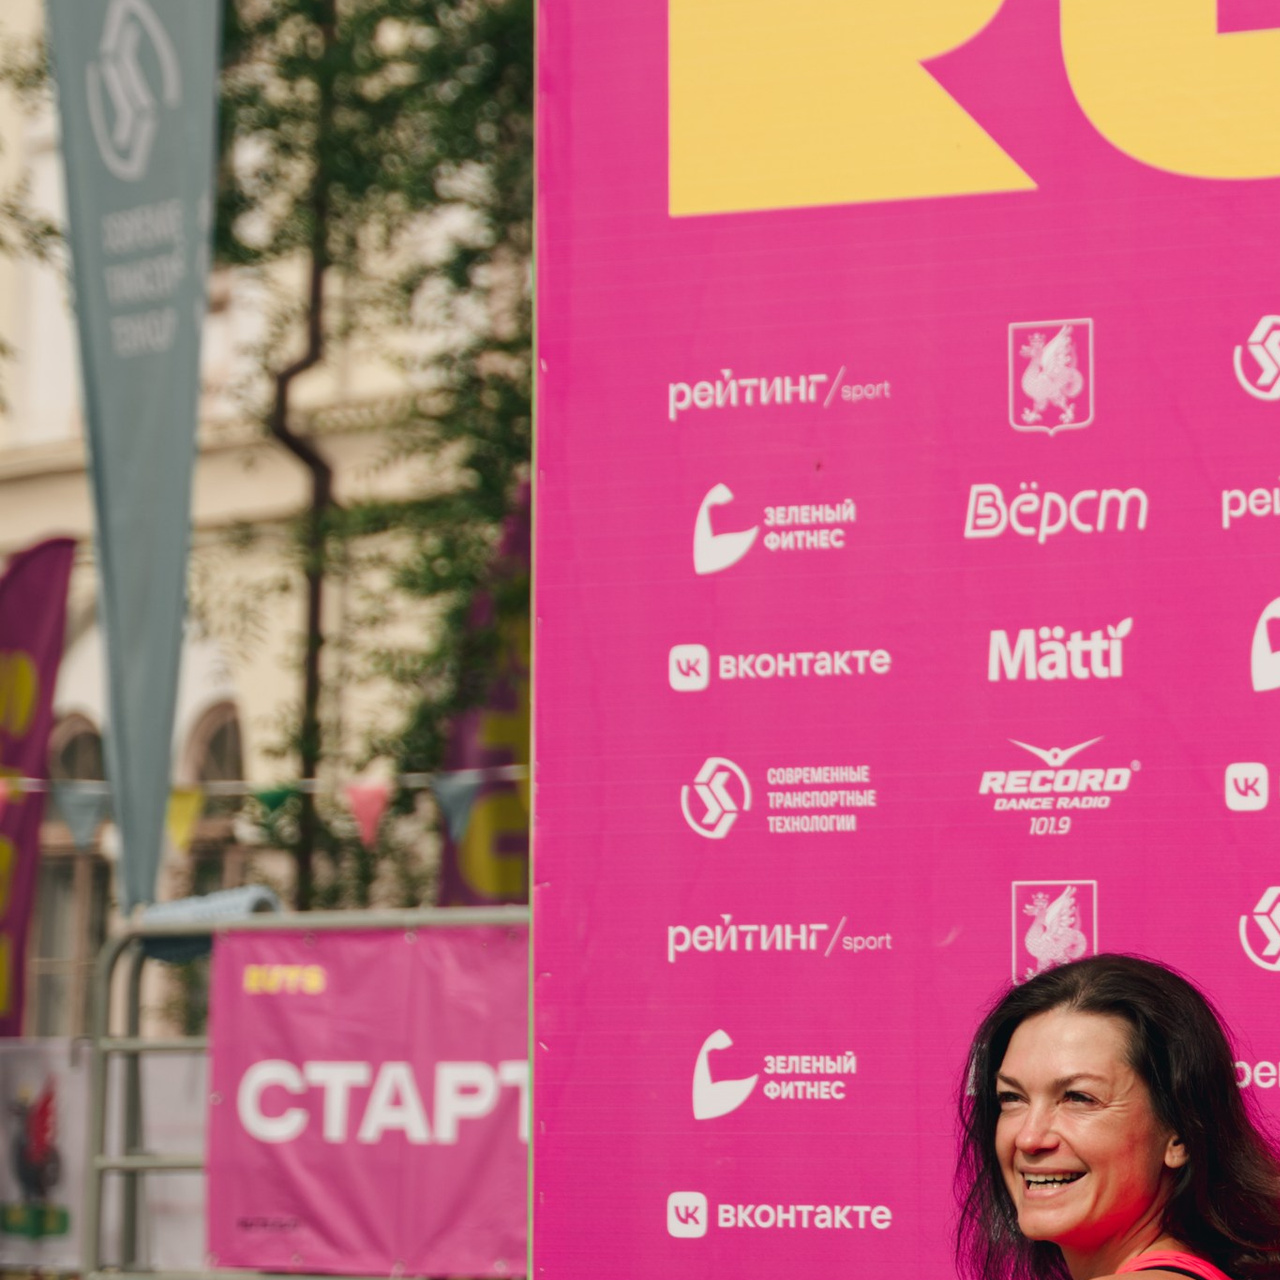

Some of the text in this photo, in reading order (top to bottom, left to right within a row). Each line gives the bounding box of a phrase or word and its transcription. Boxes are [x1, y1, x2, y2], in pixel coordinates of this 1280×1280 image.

[764, 498, 856, 526] ЗЕЛЕНЫЙ
[764, 528, 844, 551] ФИТНЕС
[988, 617, 1133, 681] Mätti
[719, 649, 891, 679] вконтакте
[767, 765, 870, 785] СОВРЕМЕННЫЕ
[767, 790, 876, 809] ТРАНСПОРТНЫЕ
[994, 796, 1111, 811] DANCE RADIO
[767, 814, 856, 833] ТЕХНОЛОГИИ
[1030, 816, 1071, 835] 101.9
[764, 1051, 856, 1074] ЗЕЛЕНЫЙ
[764, 1081, 845, 1099] ФИТНЕС
[718, 1204, 892, 1229] вконтакте
